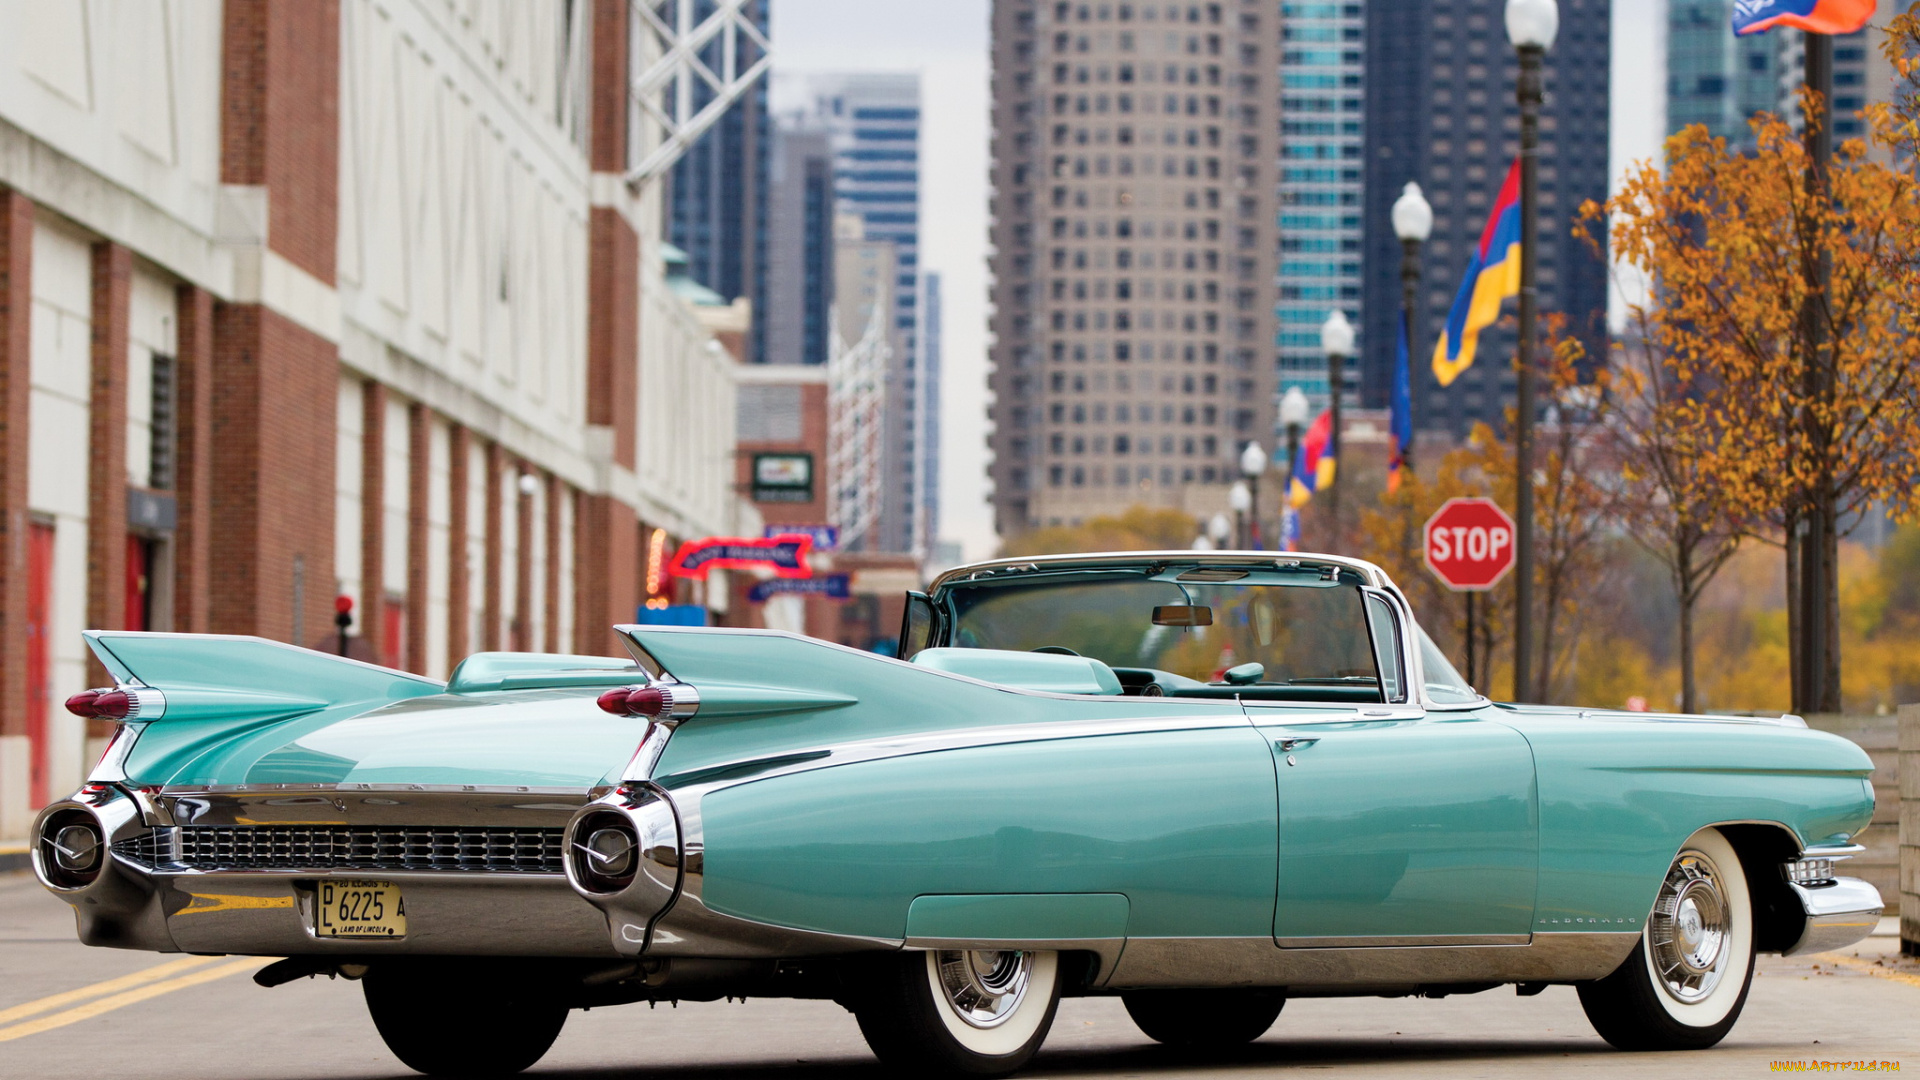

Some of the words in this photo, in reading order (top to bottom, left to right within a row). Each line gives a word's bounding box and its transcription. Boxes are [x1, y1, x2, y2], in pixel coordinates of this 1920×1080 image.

[1431, 526, 1509, 562] STOP
[339, 891, 384, 921] 6225
[397, 895, 405, 917] A
